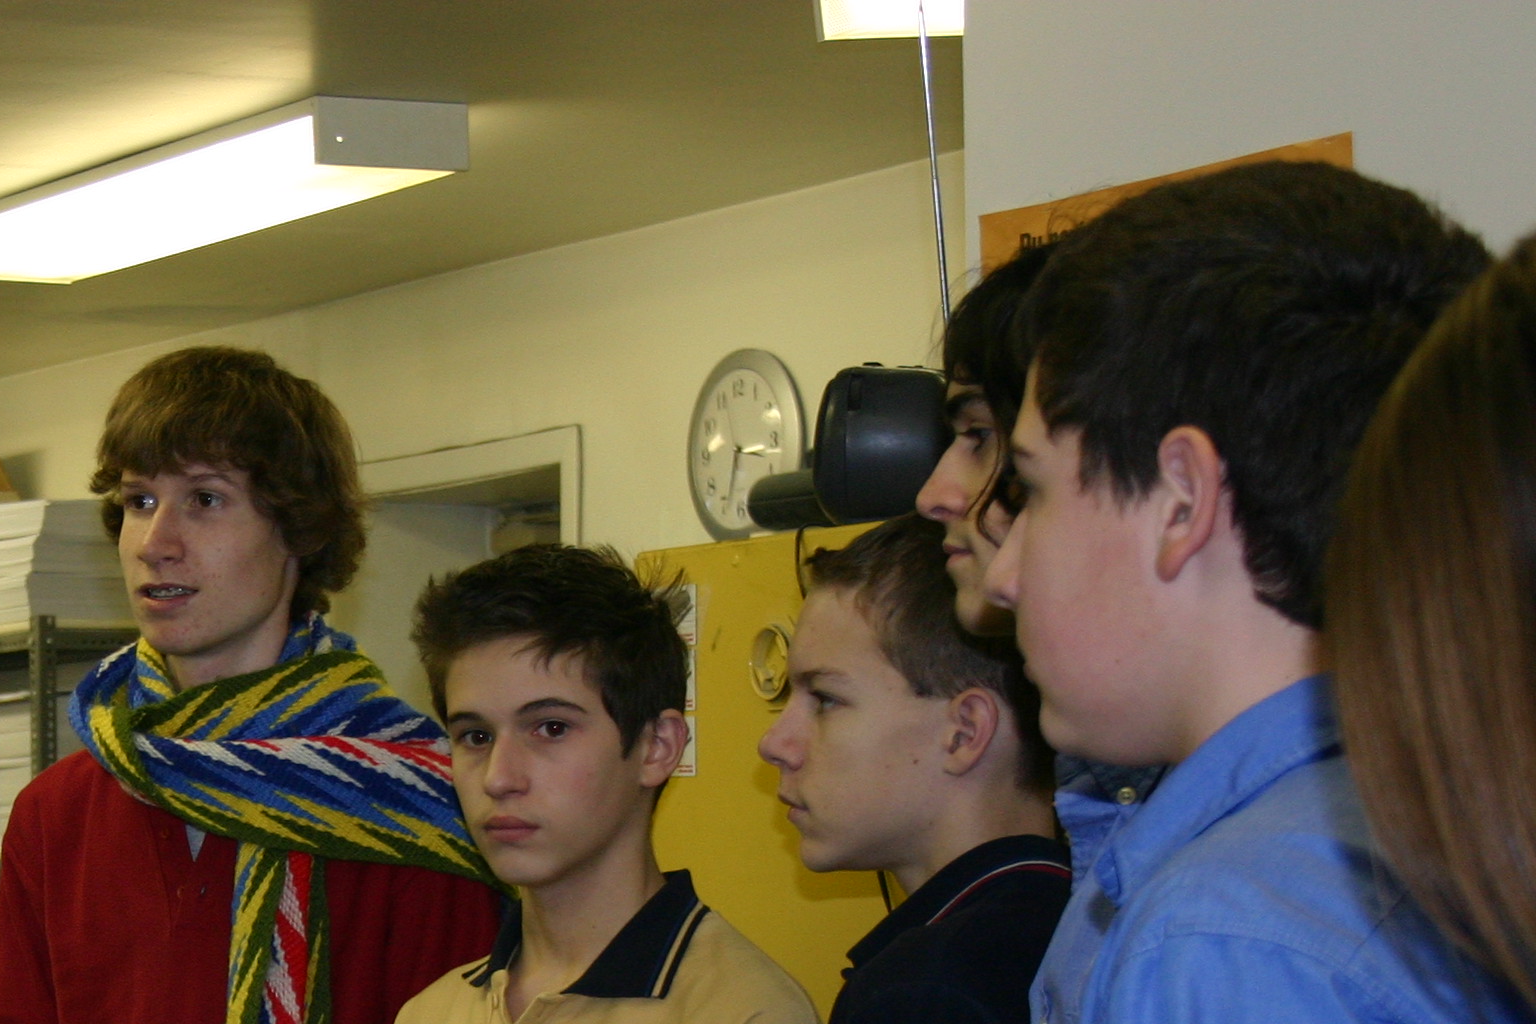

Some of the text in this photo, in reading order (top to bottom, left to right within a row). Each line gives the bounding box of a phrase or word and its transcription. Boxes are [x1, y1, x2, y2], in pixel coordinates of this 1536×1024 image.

[732, 378, 745, 398] 12
[717, 391, 726, 409] 11
[770, 431, 778, 447] 3
